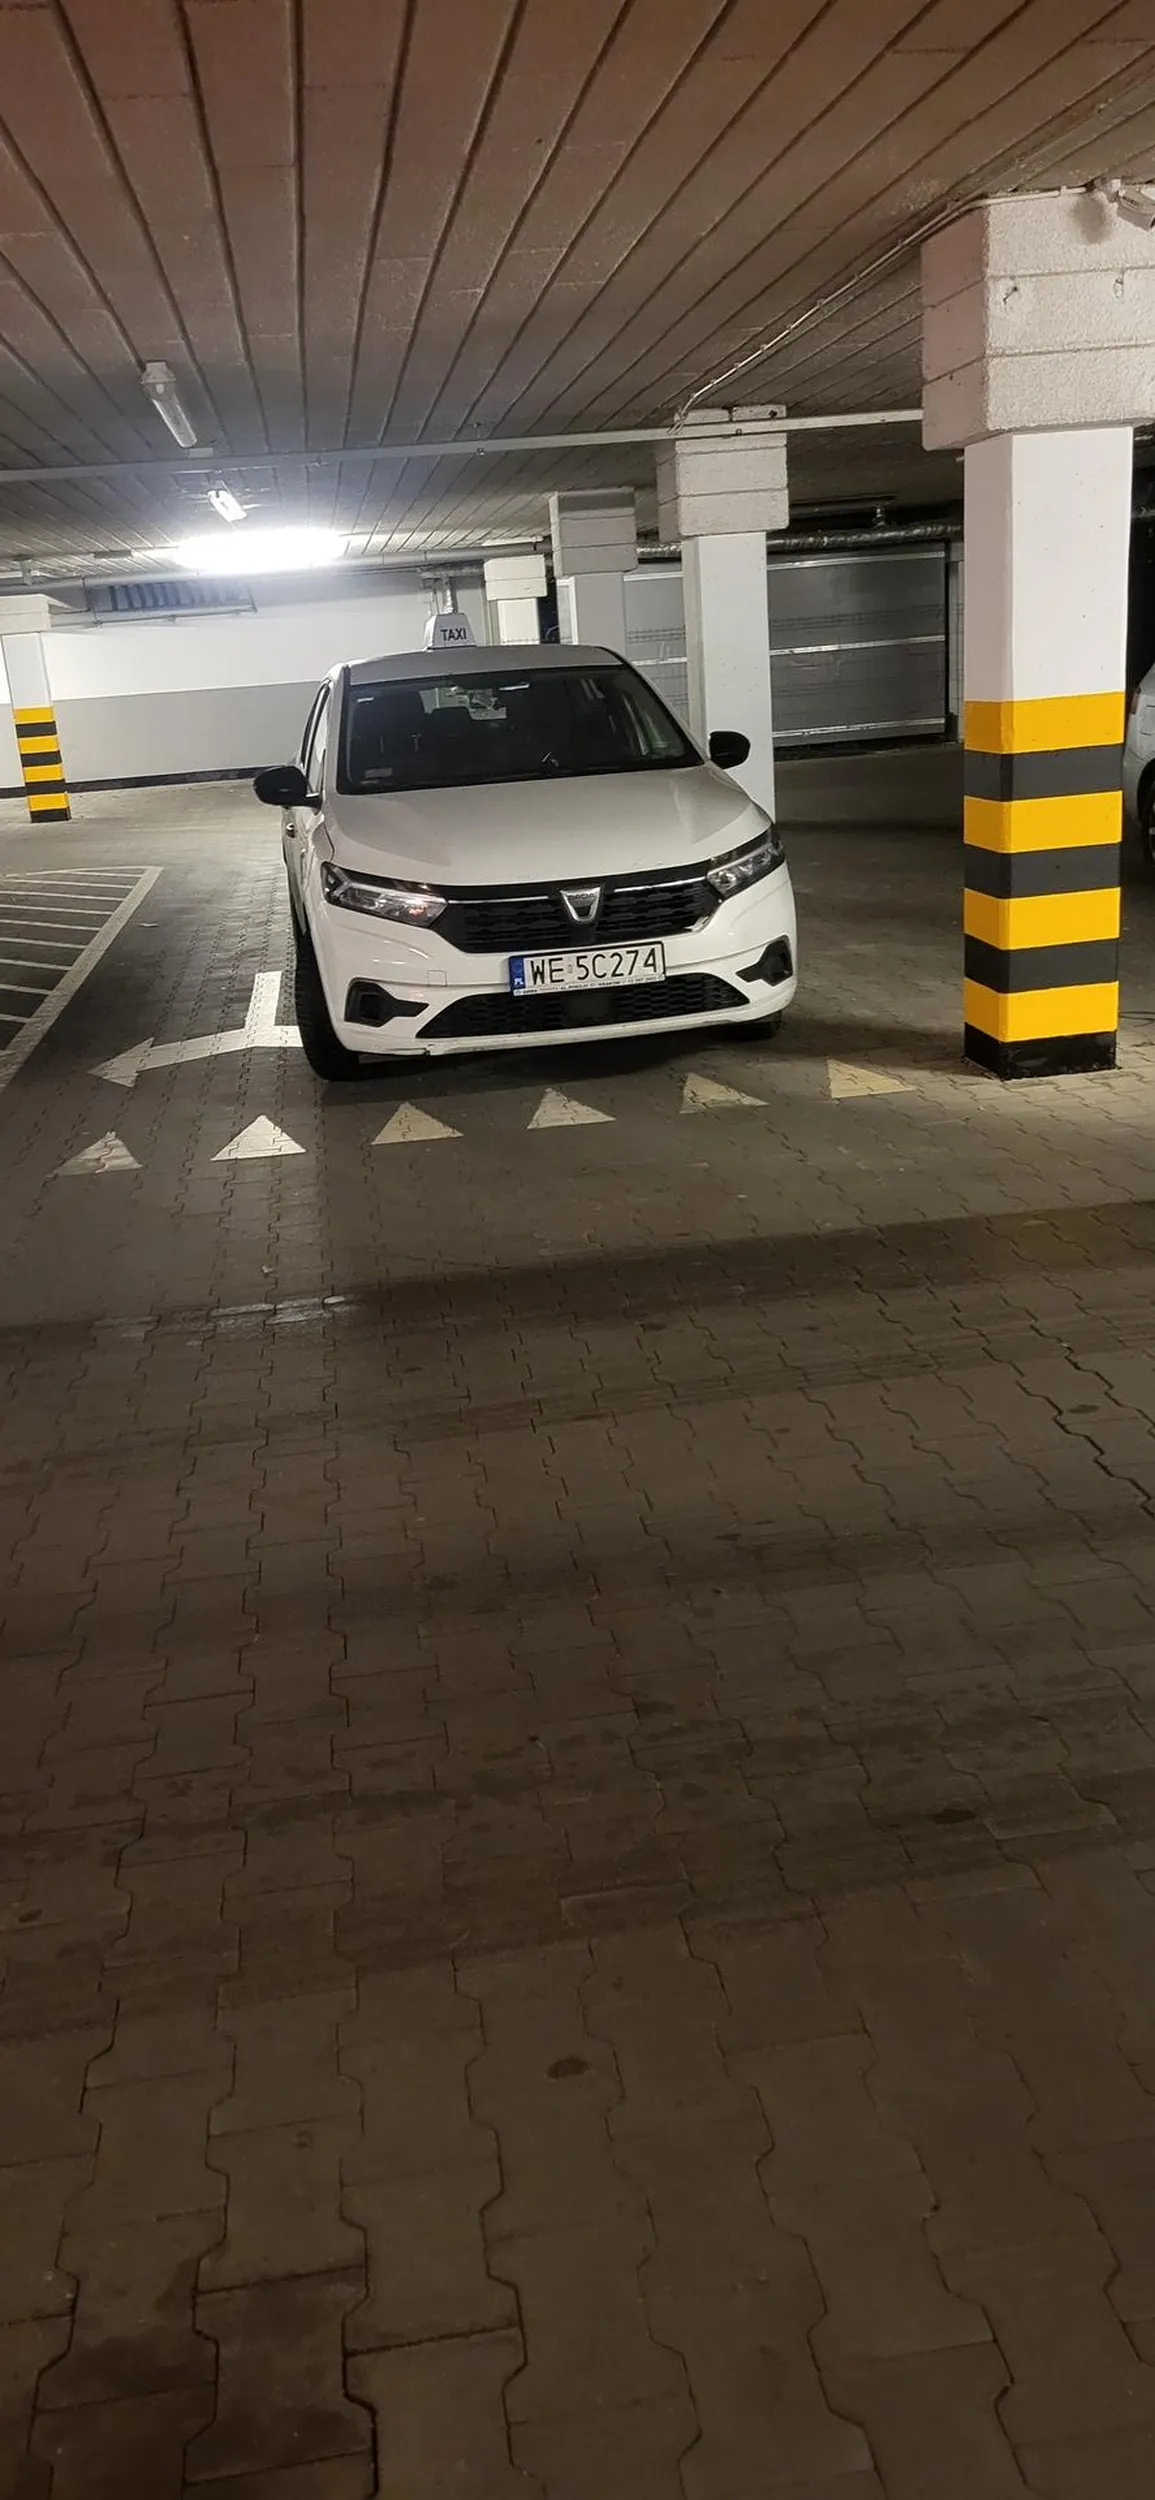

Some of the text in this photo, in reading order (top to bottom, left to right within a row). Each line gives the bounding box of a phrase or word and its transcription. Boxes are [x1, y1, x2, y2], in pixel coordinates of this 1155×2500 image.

[440, 627, 467, 641] TAXI
[530, 957, 565, 985] WE
[576, 948, 657, 980] 5C274
